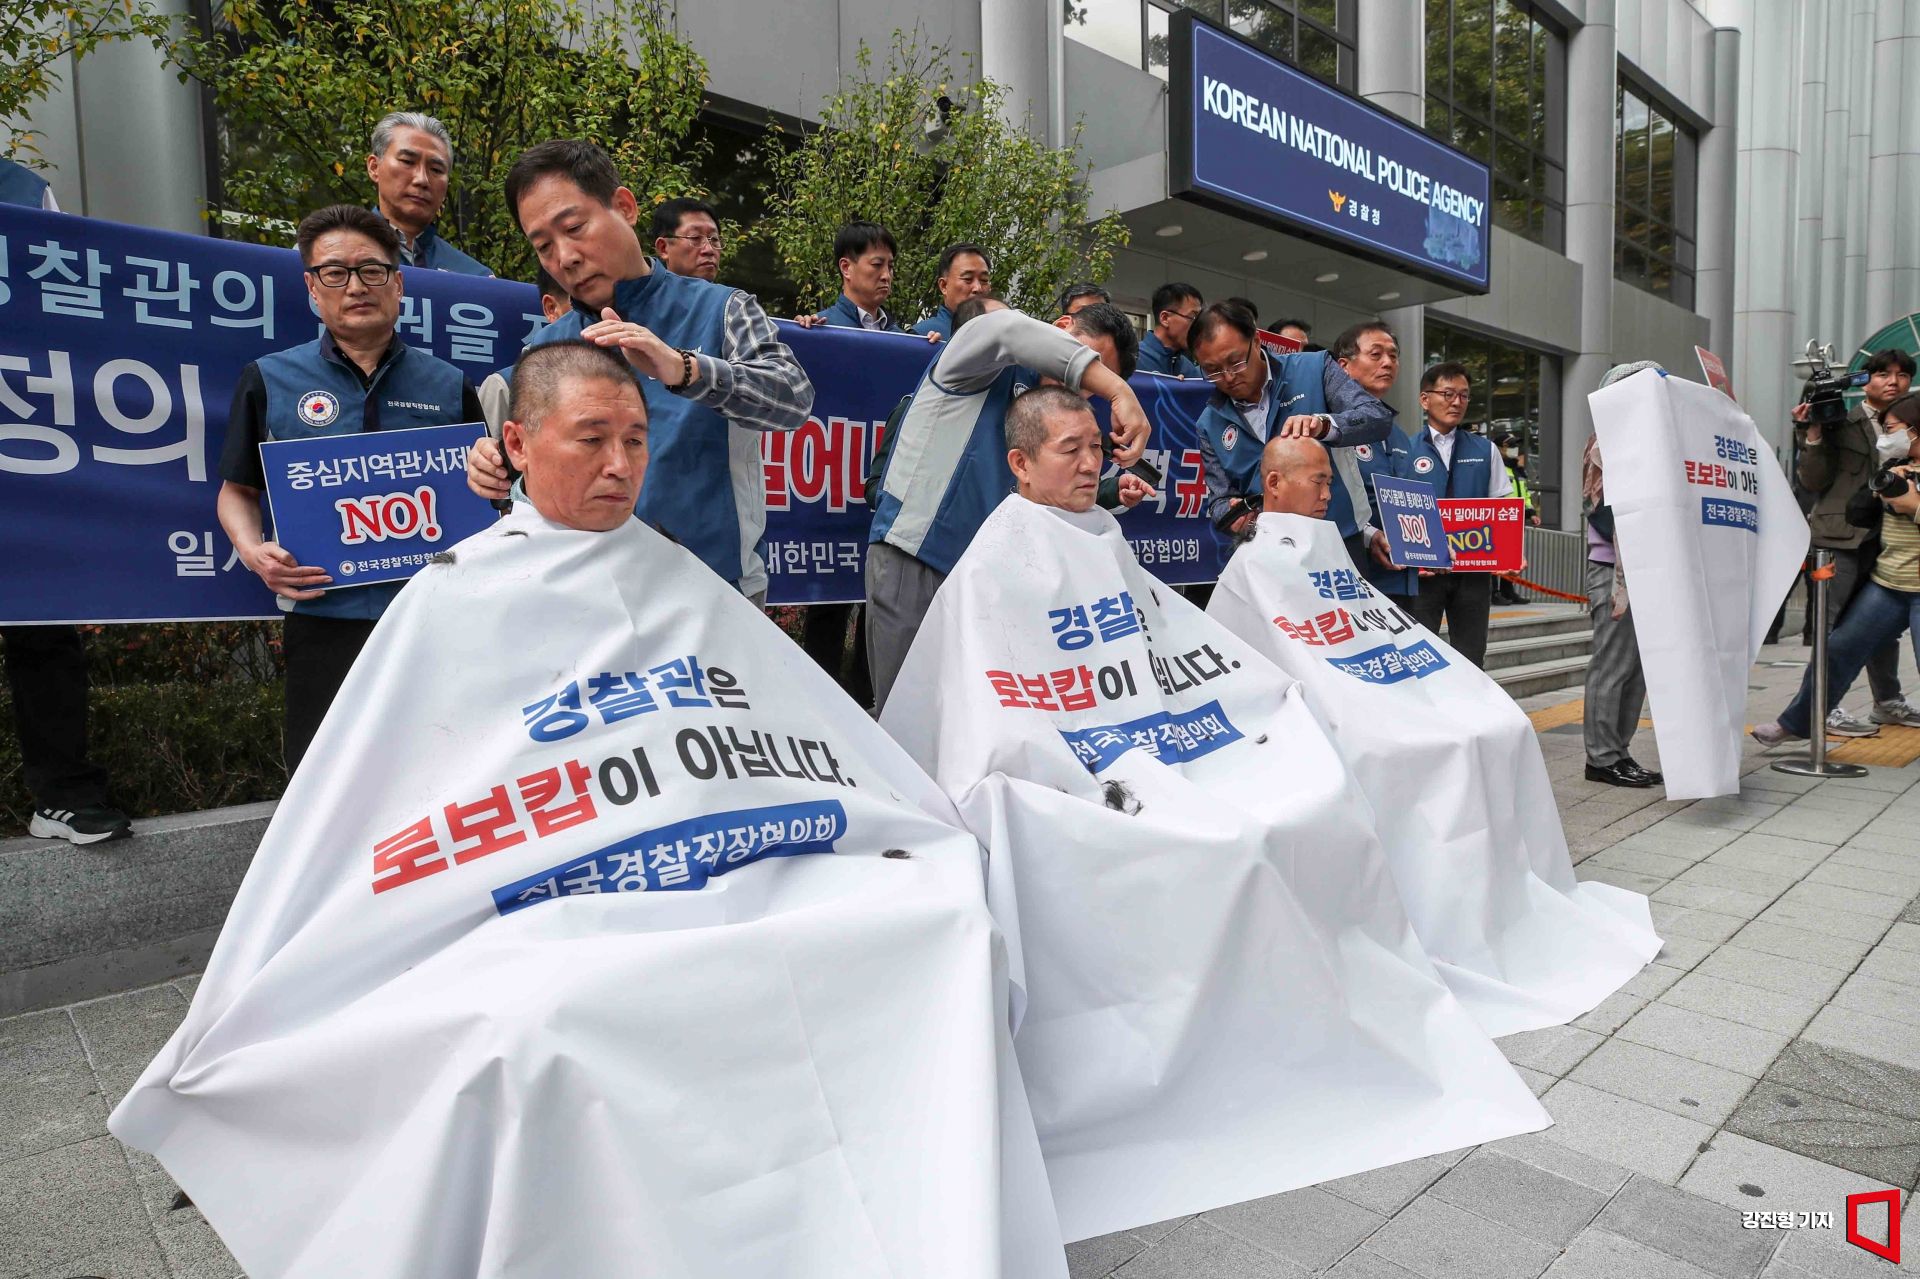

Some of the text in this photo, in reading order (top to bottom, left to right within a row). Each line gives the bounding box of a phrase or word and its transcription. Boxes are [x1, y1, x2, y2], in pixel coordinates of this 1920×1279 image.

[1203, 75, 1484, 227] KOREAN NATIONAL POLICE AGENCY
[1348, 199, 1381, 226] 경찰청
[287, 445, 471, 490] 중심지역관서제
[336, 487, 441, 543] NO!
[1398, 514, 1431, 548] NO!
[1439, 507, 1520, 522] 식 밀어내기 순찰
[1446, 525, 1492, 551] NO!
[357, 551, 448, 572] 전국경찰직장협
[522, 655, 751, 743] 경찰관은
[986, 660, 1138, 712] 로보캅이
[372, 725, 858, 895] 로보캅이 아닙니다.
